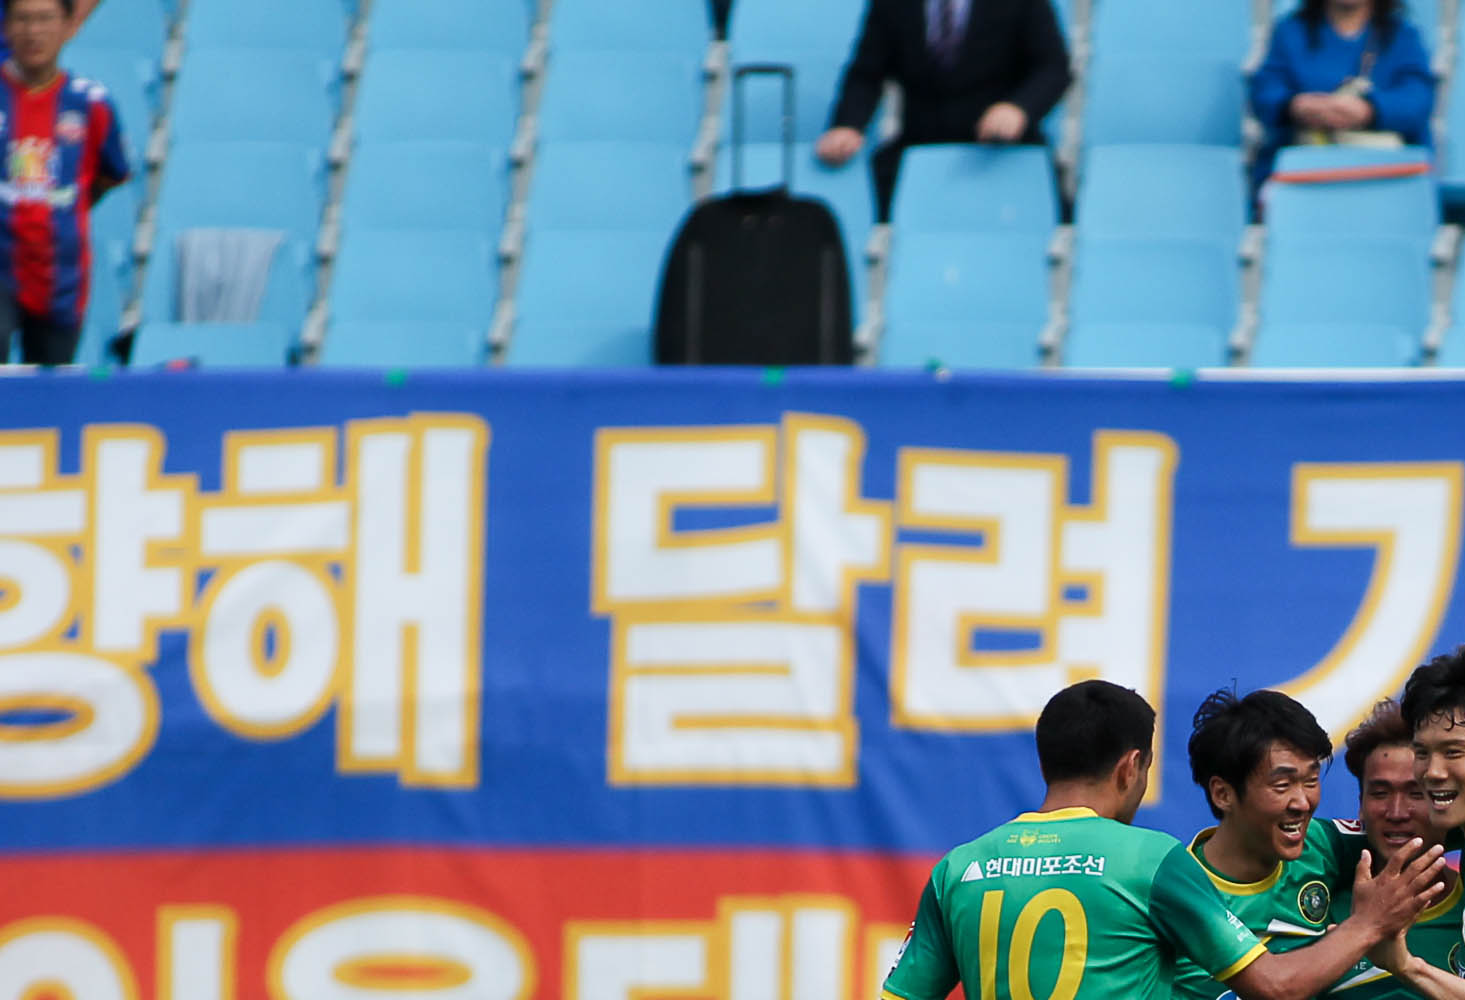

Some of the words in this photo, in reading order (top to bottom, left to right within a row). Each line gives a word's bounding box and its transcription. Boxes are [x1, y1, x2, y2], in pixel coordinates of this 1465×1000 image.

[0, 411, 488, 798] 향해
[590, 411, 1180, 806] 달려
[985, 855, 1106, 879] 현대미포조선
